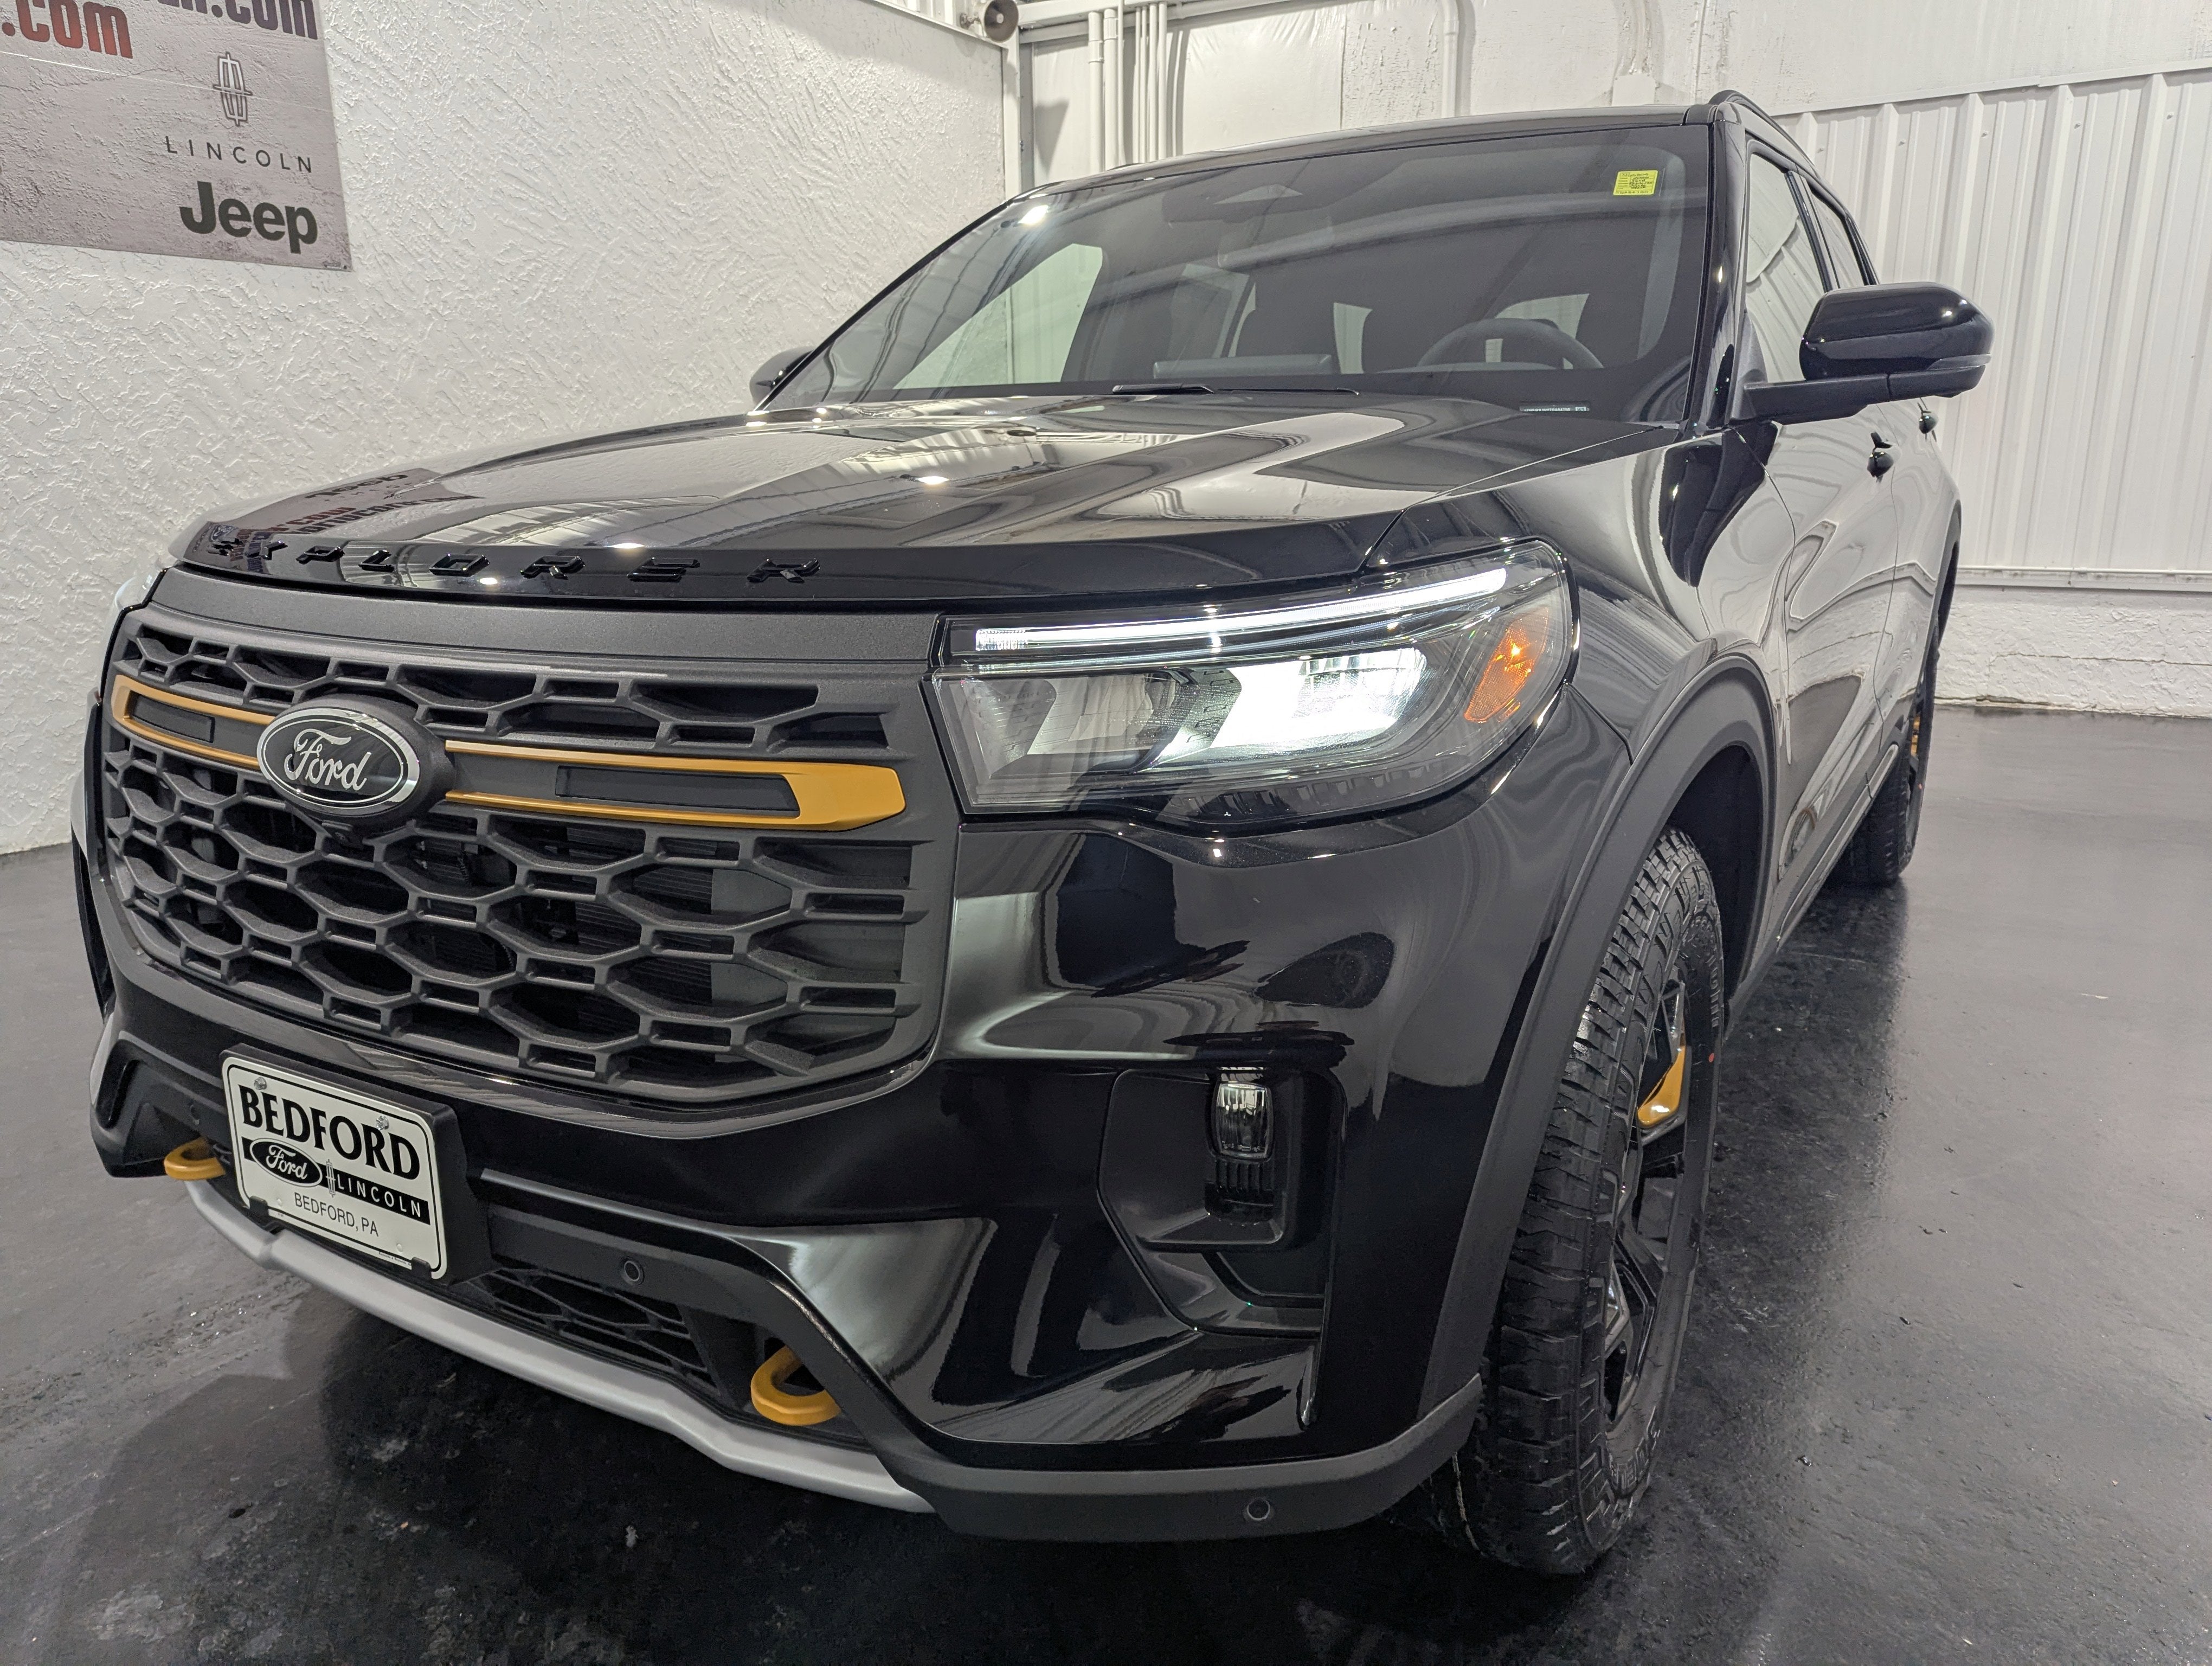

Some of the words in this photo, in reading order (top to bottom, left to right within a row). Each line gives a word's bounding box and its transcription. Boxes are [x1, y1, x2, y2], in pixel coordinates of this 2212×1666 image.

[157, 0, 318, 40] .com
[164, 136, 312, 173] LINCOLN
[179, 181, 318, 254] Jeep
[284, 728, 372, 791] Ford
[237, 1085, 420, 1181] BEDFORD
[266, 1144, 308, 1180] Ford
[294, 1191, 359, 1232] BEDFORD,
[361, 1216, 380, 1237] PA
[337, 1174, 421, 1218] LINCOLN
